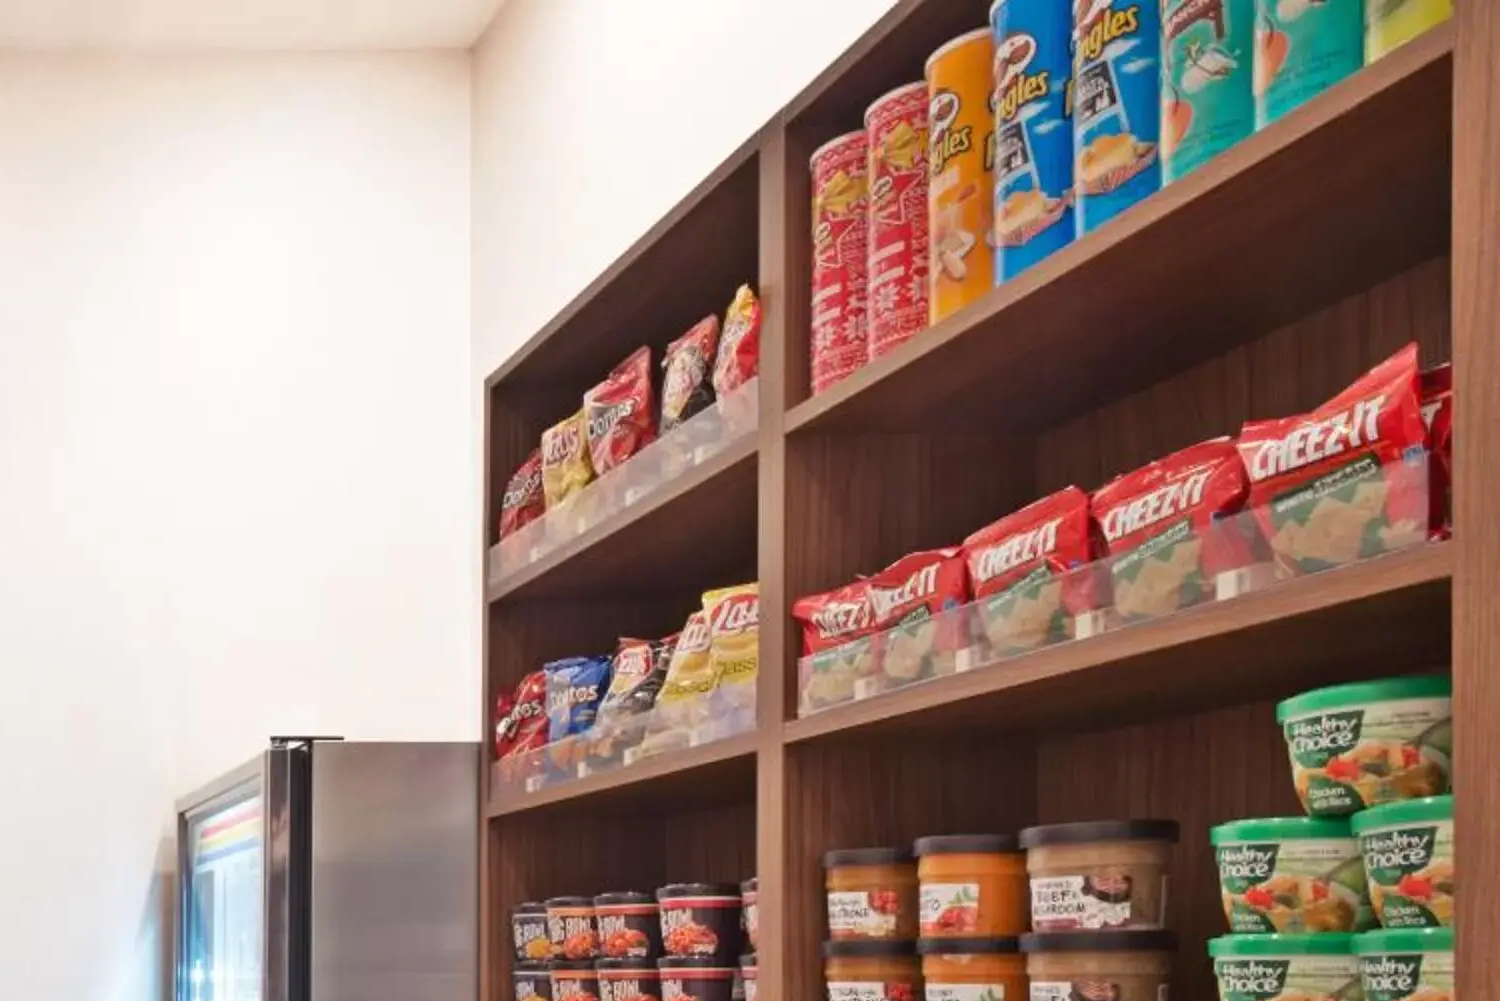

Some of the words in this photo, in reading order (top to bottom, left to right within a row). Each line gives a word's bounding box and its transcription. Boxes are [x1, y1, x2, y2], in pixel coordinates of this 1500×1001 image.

[1293, 714, 1358, 740] Healthy
[1294, 731, 1354, 752] Choice
[1365, 831, 1430, 851] Healthy
[1221, 844, 1274, 863] Healthy
[1365, 847, 1427, 870] Choice
[1223, 960, 1284, 979] Healthy
